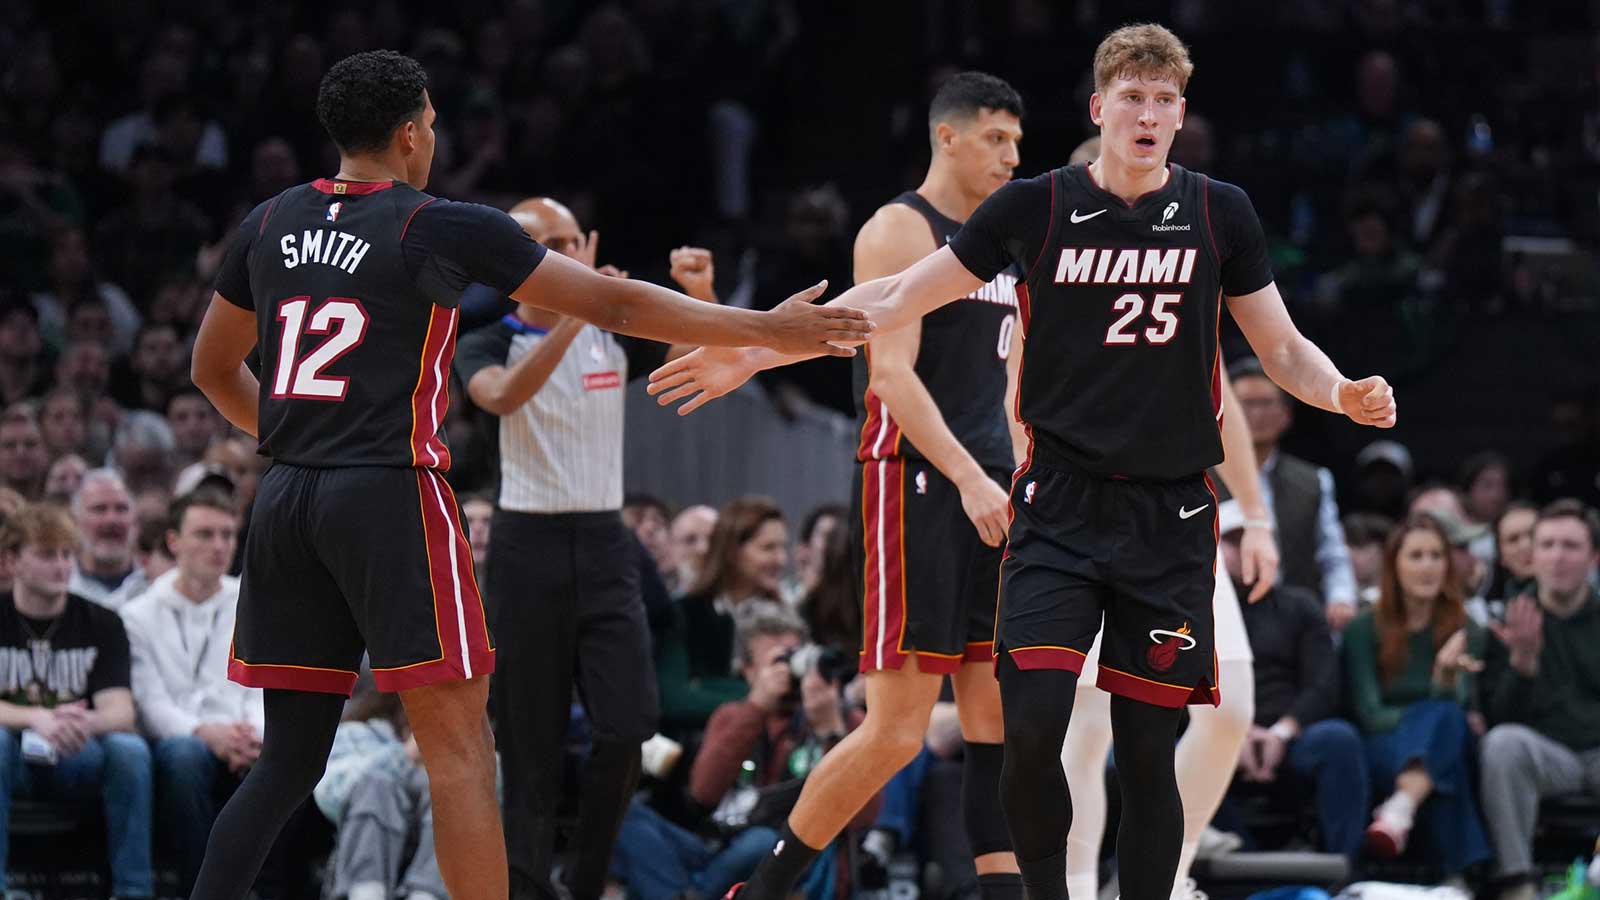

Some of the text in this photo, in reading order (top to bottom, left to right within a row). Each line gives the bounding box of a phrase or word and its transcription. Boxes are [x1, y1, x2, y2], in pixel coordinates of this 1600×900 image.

[1152, 224, 1191, 232] Robinhood
[280, 229, 371, 274] SMITH
[1054, 247, 1198, 284] MIAMI
[961, 272, 1018, 307] AMI
[996, 313, 1015, 360] 0
[1104, 292, 1184, 346] 25
[270, 296, 371, 402] 12
